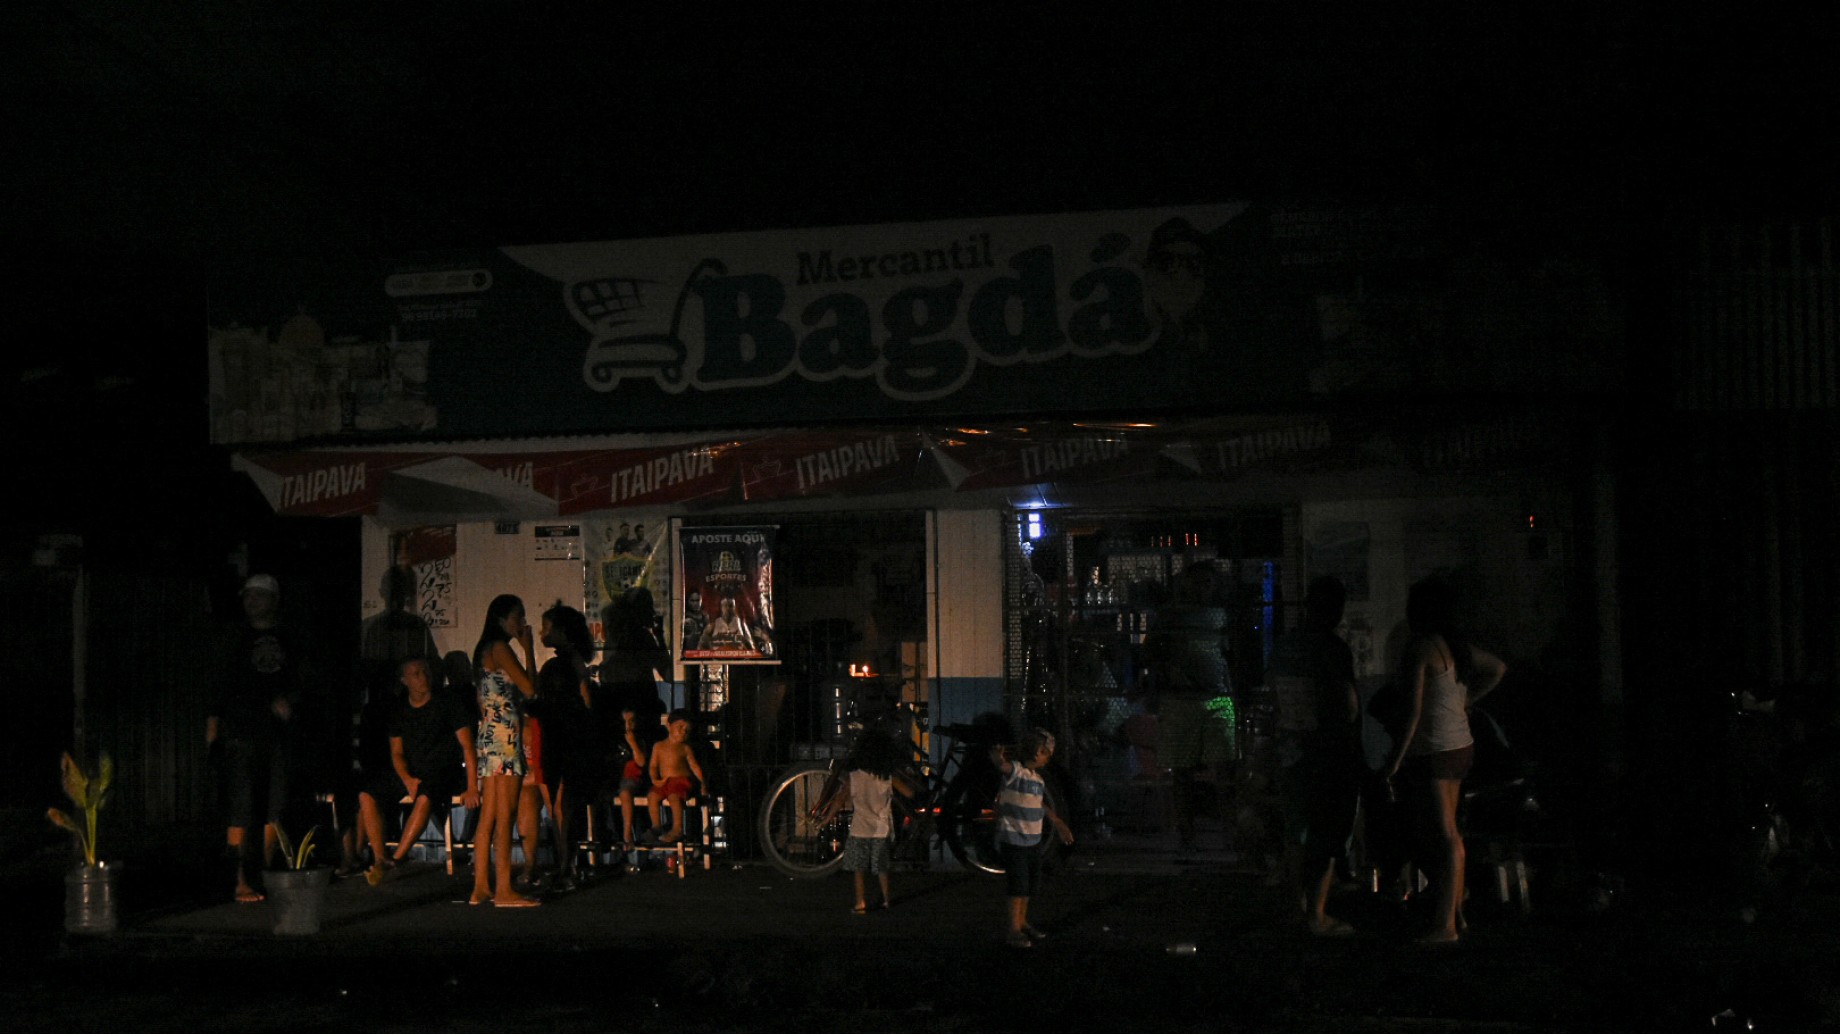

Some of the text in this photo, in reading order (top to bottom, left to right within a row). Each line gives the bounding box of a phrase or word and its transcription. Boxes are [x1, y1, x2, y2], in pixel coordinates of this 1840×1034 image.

[797, 232, 994, 286] Mercantil
[698, 232, 1157, 385] Bagdá
[795, 434, 900, 490] ITAIPAVA
[1020, 433, 1129, 480] ITAIPAVA
[1216, 421, 1332, 470] ITAIPAVA
[610, 447, 714, 504] ITAIPAVA
[691, 534, 733, 544] APOSTE
[705, 573, 747, 583] ESPORTES
